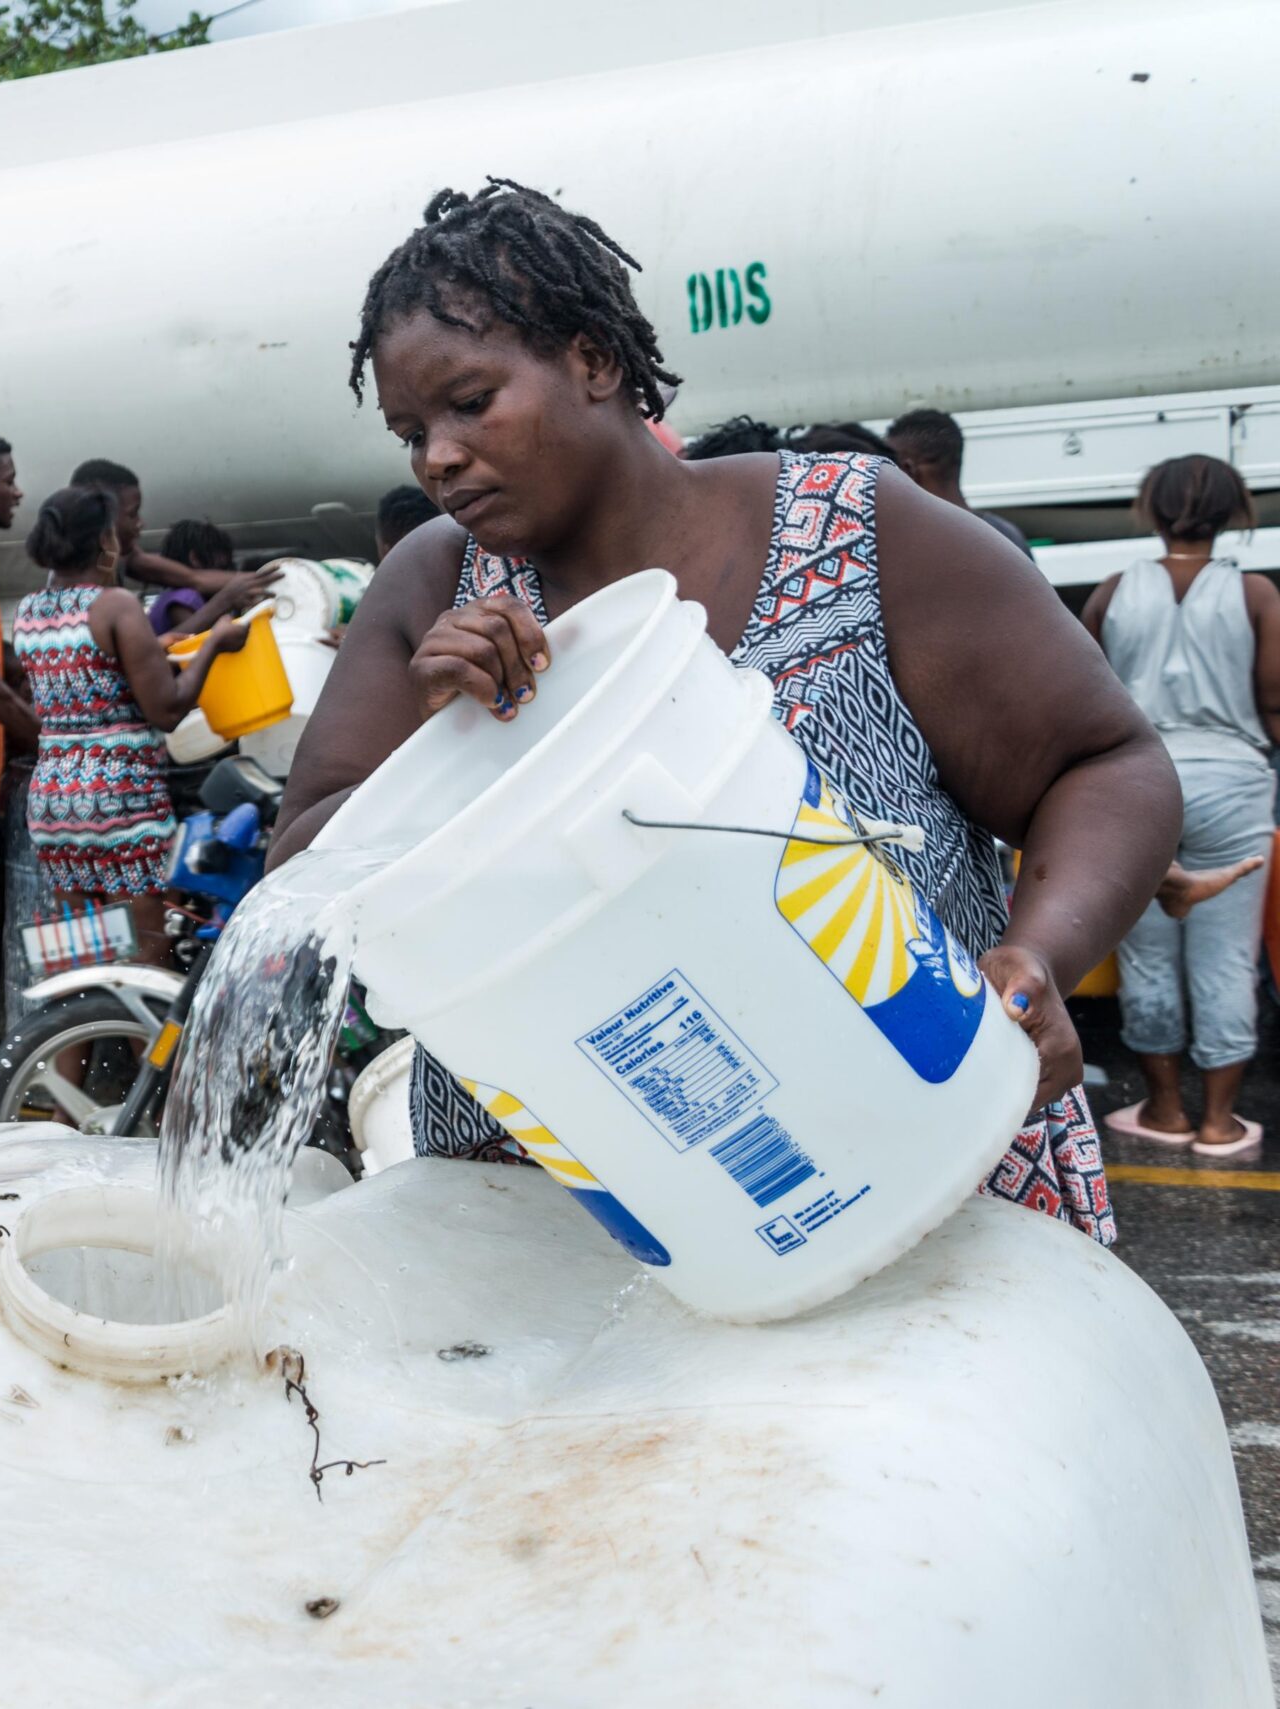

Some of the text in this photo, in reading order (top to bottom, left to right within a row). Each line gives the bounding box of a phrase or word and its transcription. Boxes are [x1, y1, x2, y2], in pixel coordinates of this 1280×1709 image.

[687, 261, 771, 333] DDS
[586, 980, 674, 1045] Valeur Nutritive
[615, 1009, 702, 1075] Calories 116
